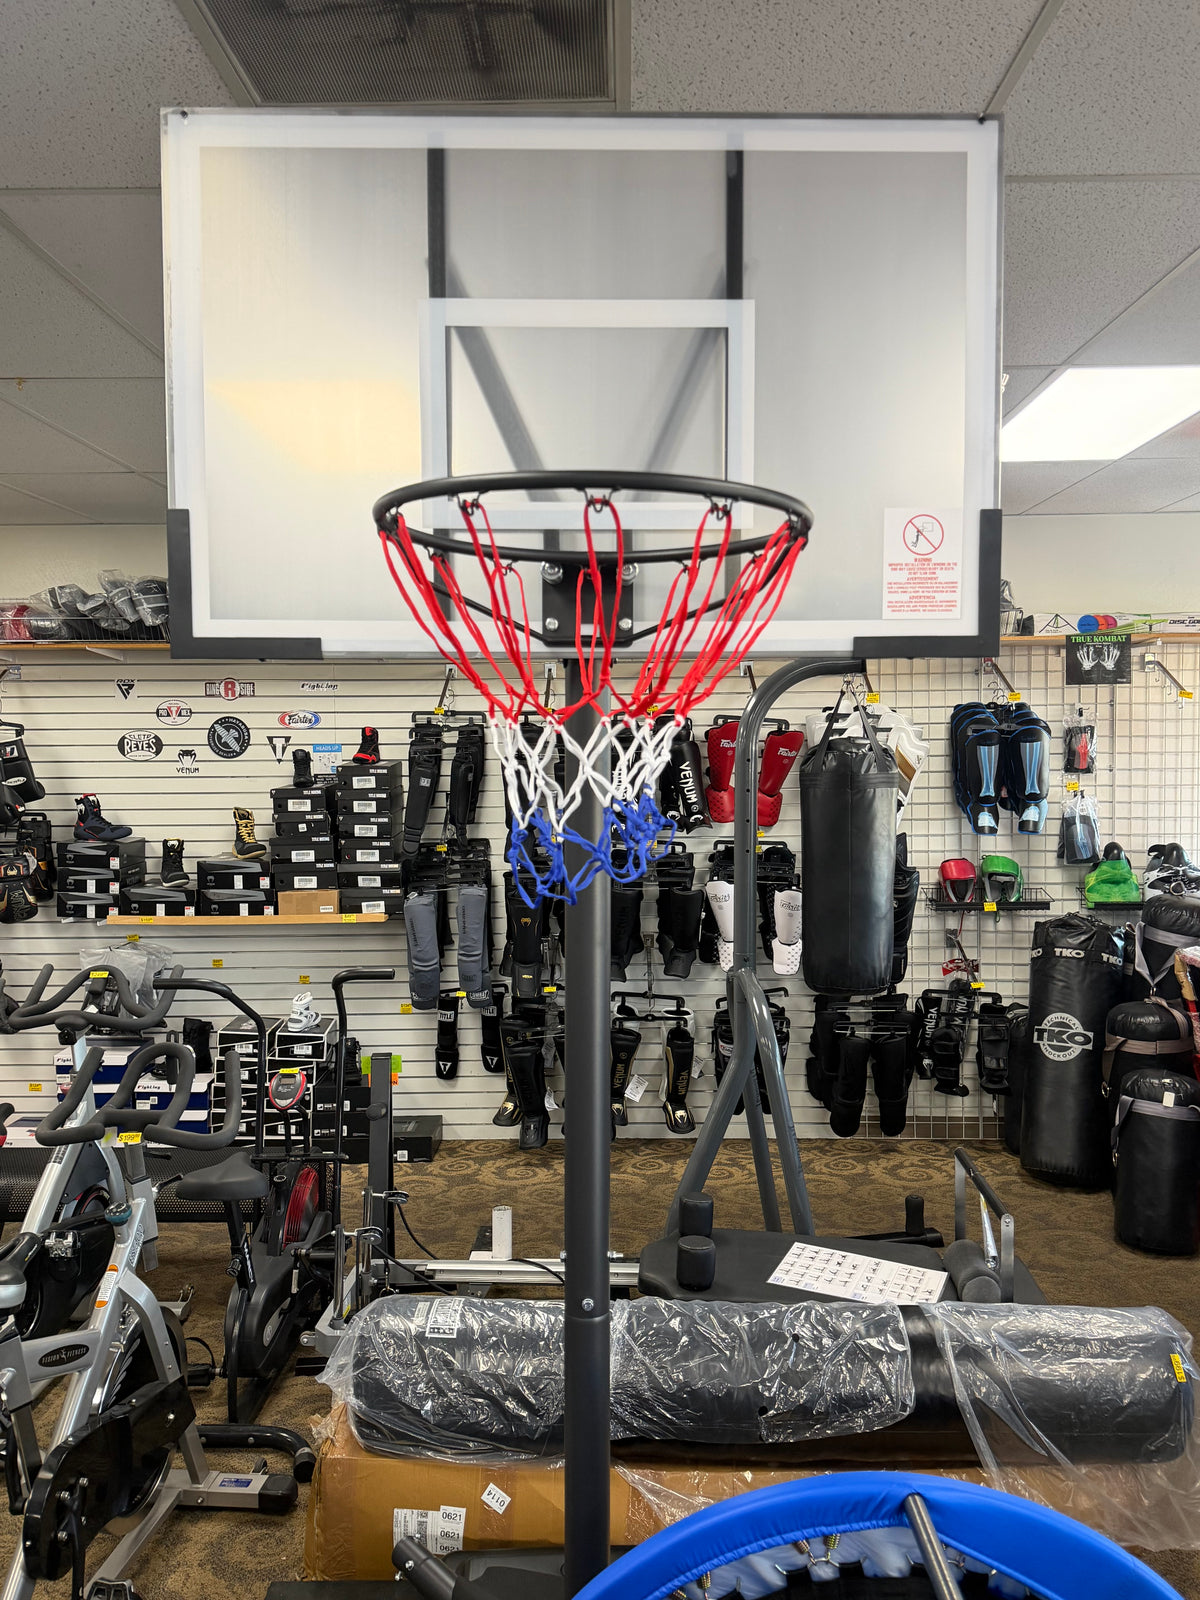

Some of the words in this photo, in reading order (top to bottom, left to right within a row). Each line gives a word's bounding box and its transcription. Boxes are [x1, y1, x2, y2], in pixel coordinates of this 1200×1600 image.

[288, 714, 314, 724] Fairtex
[124, 739, 156, 754] REYES
[679, 761, 698, 803] VENUM
[1054, 948, 1085, 958] TKO
[1101, 952, 1122, 966] TKO
[439, 1012, 453, 1021] TITLE
[923, 1007, 938, 1038] VENUM
[1044, 1015, 1079, 1031] TECHNICAL
[1035, 1028, 1092, 1046] TKO
[1042, 1043, 1077, 1058] KNOCKOUT
[614, 1064, 625, 1088] VENUM
[678, 1070, 689, 1095] VENUM
[487, 1490, 505, 1507] 0114
[442, 1512, 462, 1521] 0621
[440, 1530, 460, 1539] 0621
